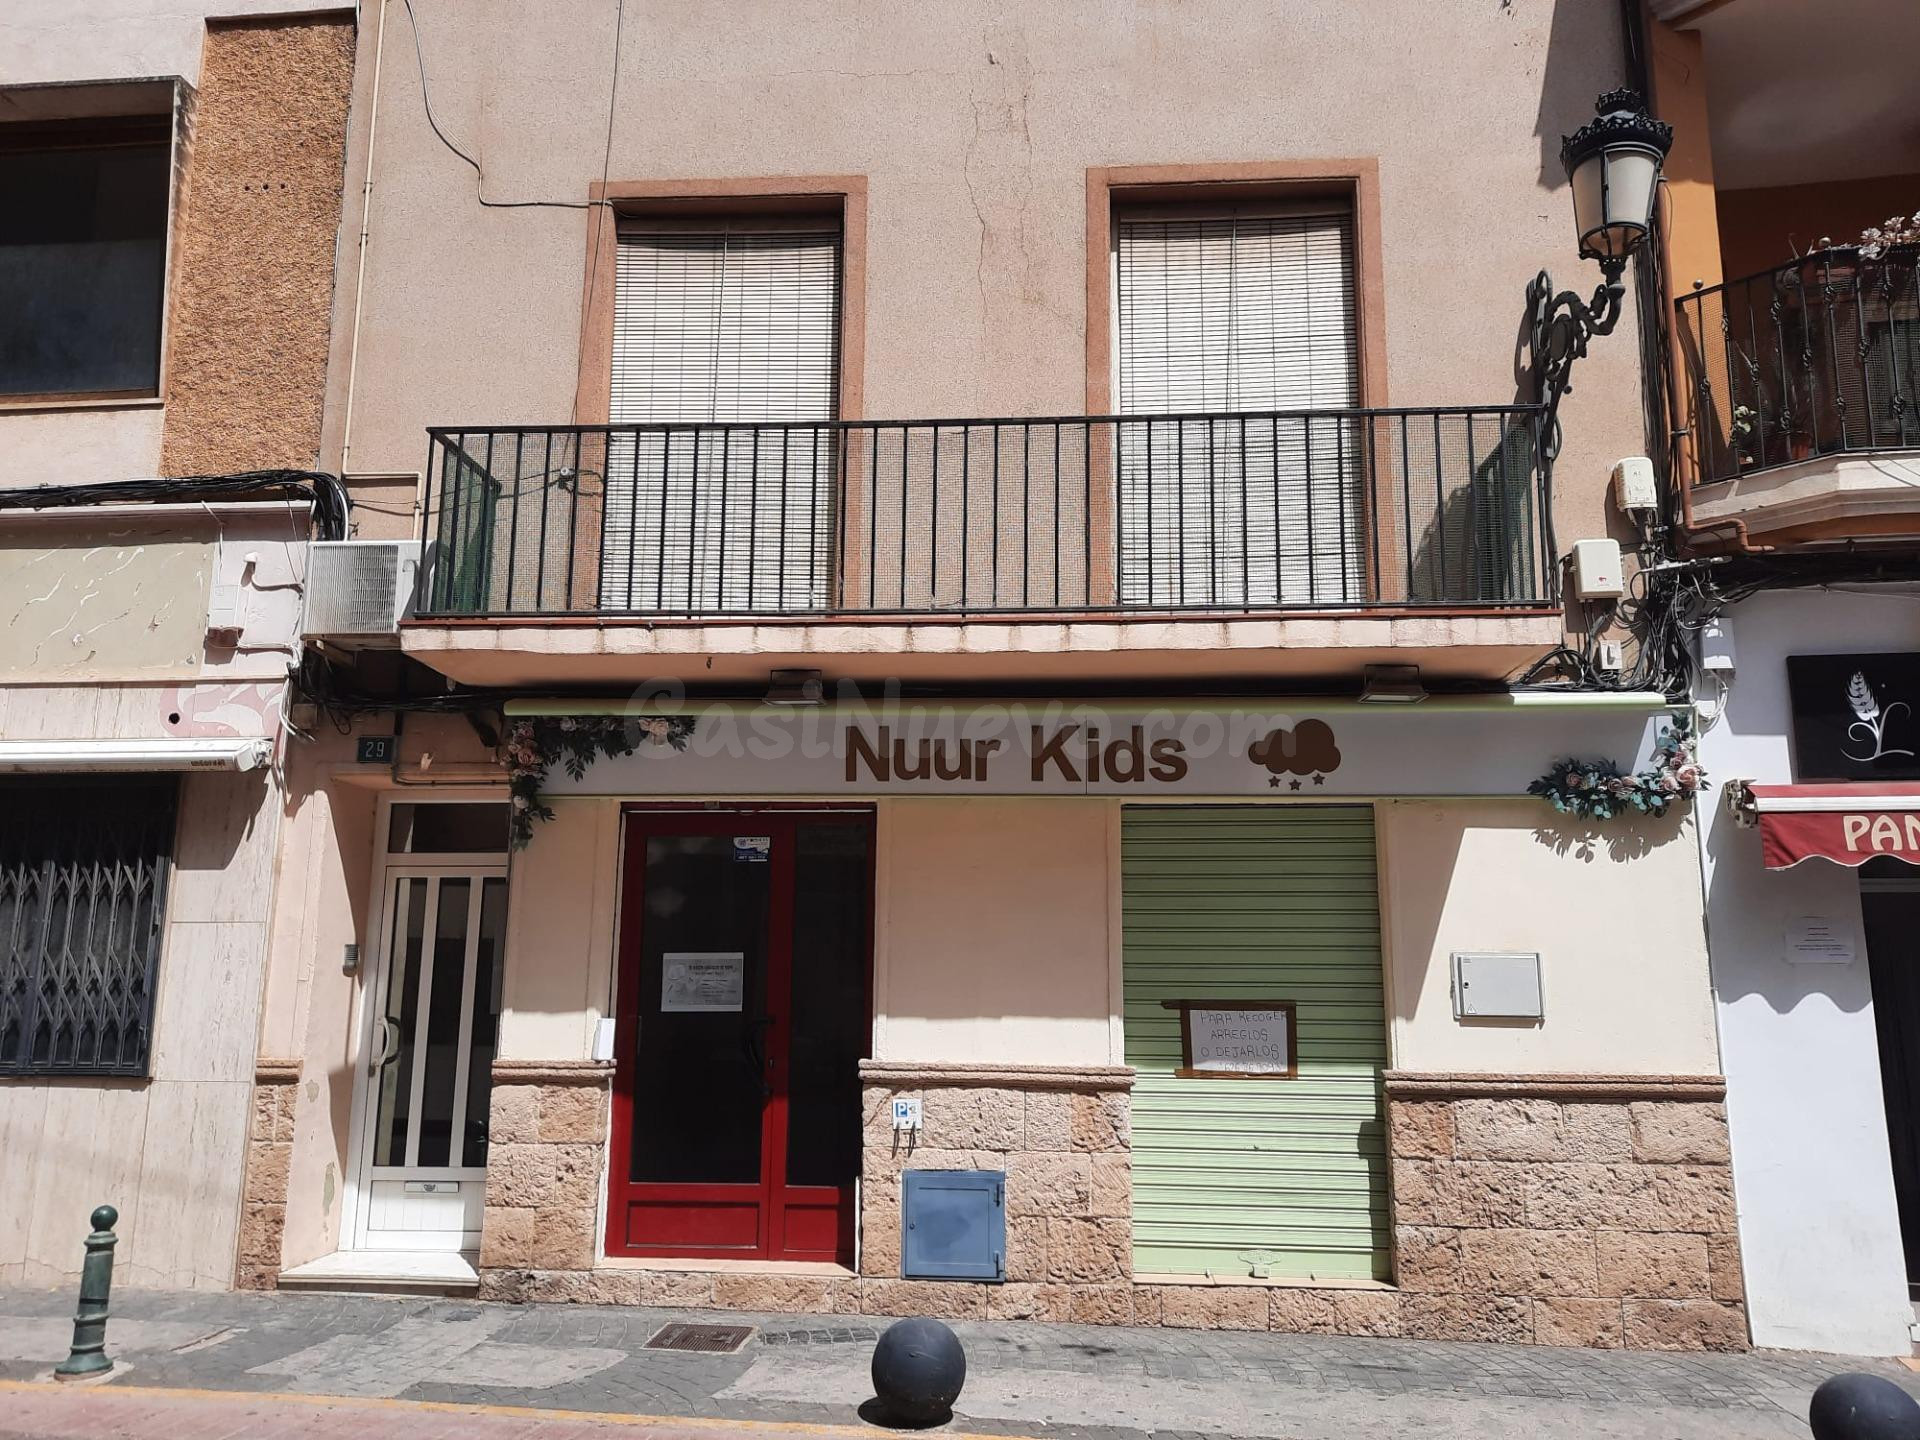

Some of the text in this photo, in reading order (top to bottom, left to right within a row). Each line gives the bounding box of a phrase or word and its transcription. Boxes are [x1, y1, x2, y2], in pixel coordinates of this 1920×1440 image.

[365, 741, 385, 758] 29
[845, 725, 1188, 783] Nuur Kids
[1200, 1011, 1233, 1025] PARA
[1211, 1028, 1268, 1042] ARREGLOS
[1201, 1043, 1280, 1061] O DEJARLOS
[897, 1103, 907, 1117] P
